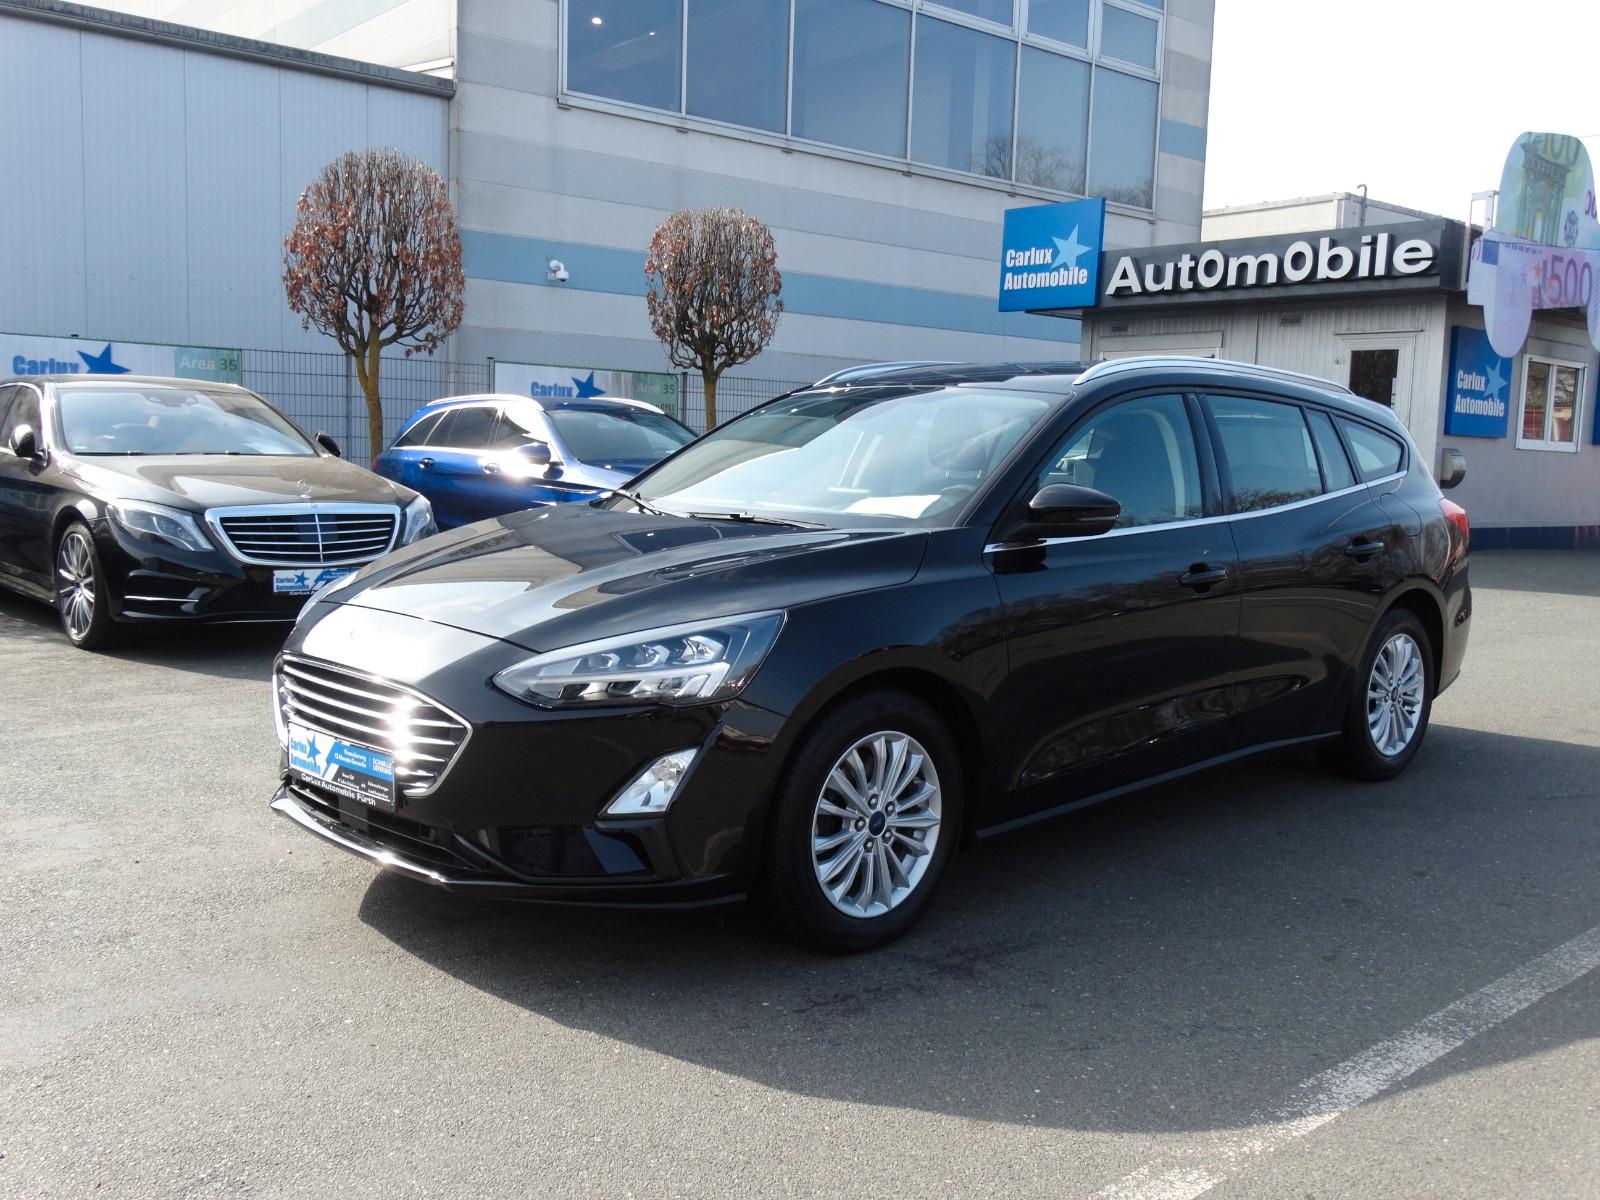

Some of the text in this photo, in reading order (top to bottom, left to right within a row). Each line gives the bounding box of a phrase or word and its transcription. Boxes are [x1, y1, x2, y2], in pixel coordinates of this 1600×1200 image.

[1005, 245, 1053, 268] Carlux
[1003, 265, 1088, 291] Automobile
[12, 355, 79, 375] Carlux
[179, 355, 238, 372] Area 35
[530, 381, 573, 397] Carlux
[663, 384, 675, 394] 35
[1457, 369, 1486, 391] Carlux
[1455, 394, 1505, 417] Automobile
[290, 737, 307, 755] Carlux
[321, 780, 356, 799] Automobile
[356, 792, 376, 806] Fürth
